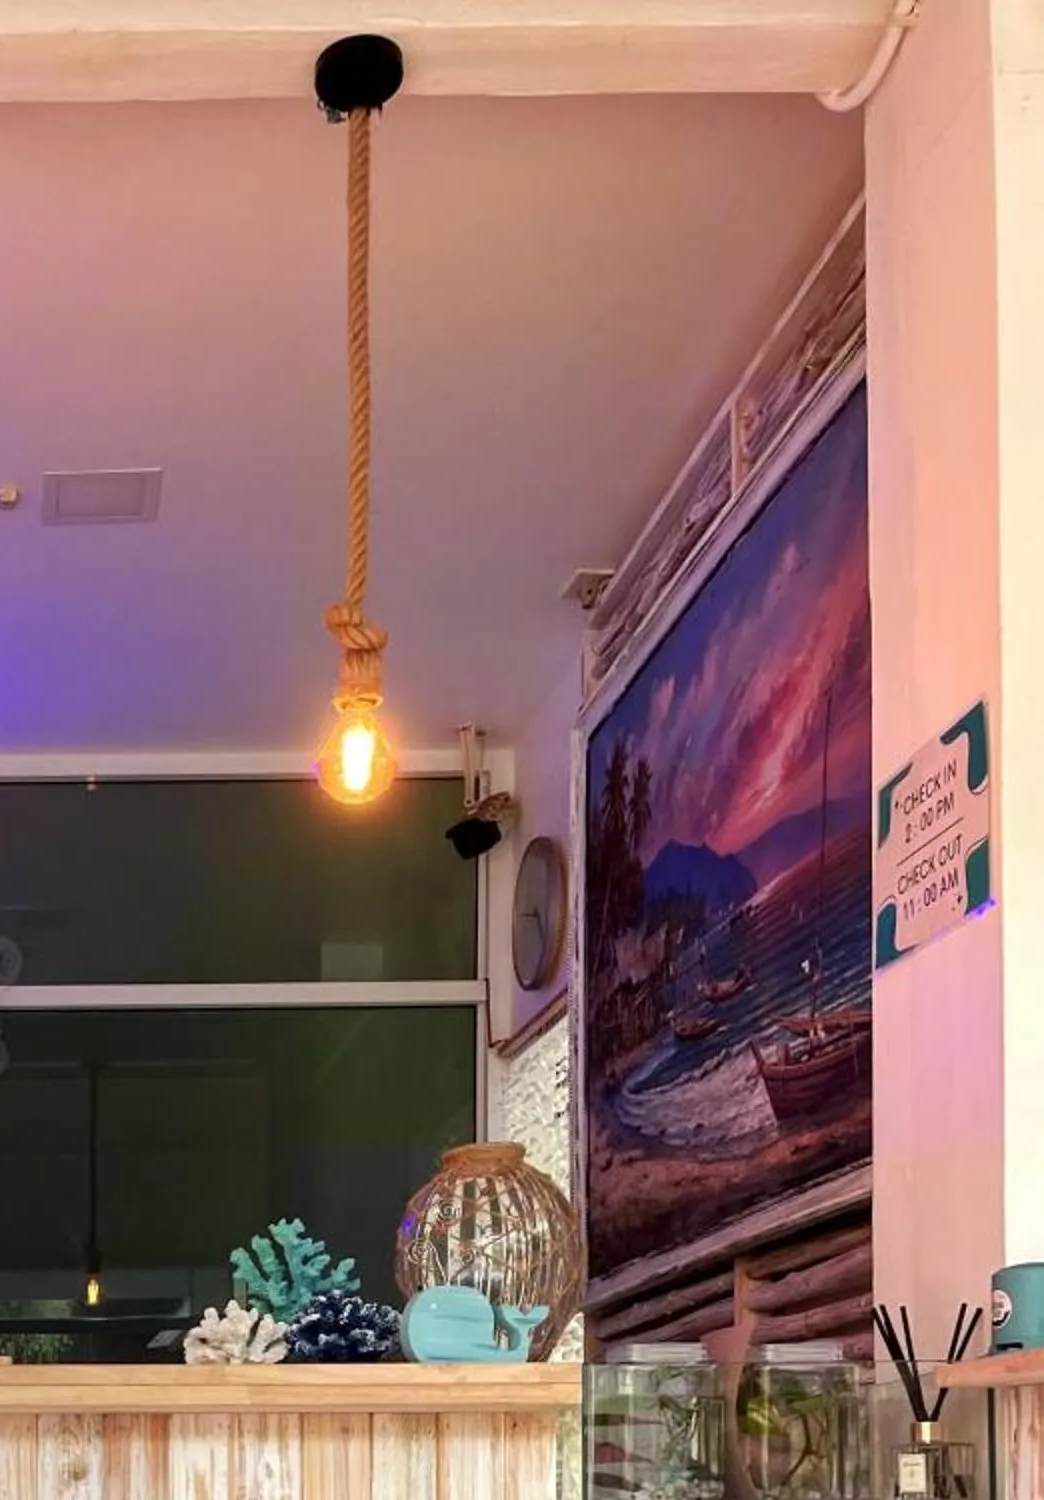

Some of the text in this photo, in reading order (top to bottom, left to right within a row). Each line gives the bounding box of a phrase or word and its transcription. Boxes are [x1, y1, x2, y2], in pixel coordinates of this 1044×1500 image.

[903, 759, 957, 815] CHECK IN
[935, 791, 955, 821] PM
[897, 834, 963, 895] CHECK OUT
[939, 867, 960, 898] AM
